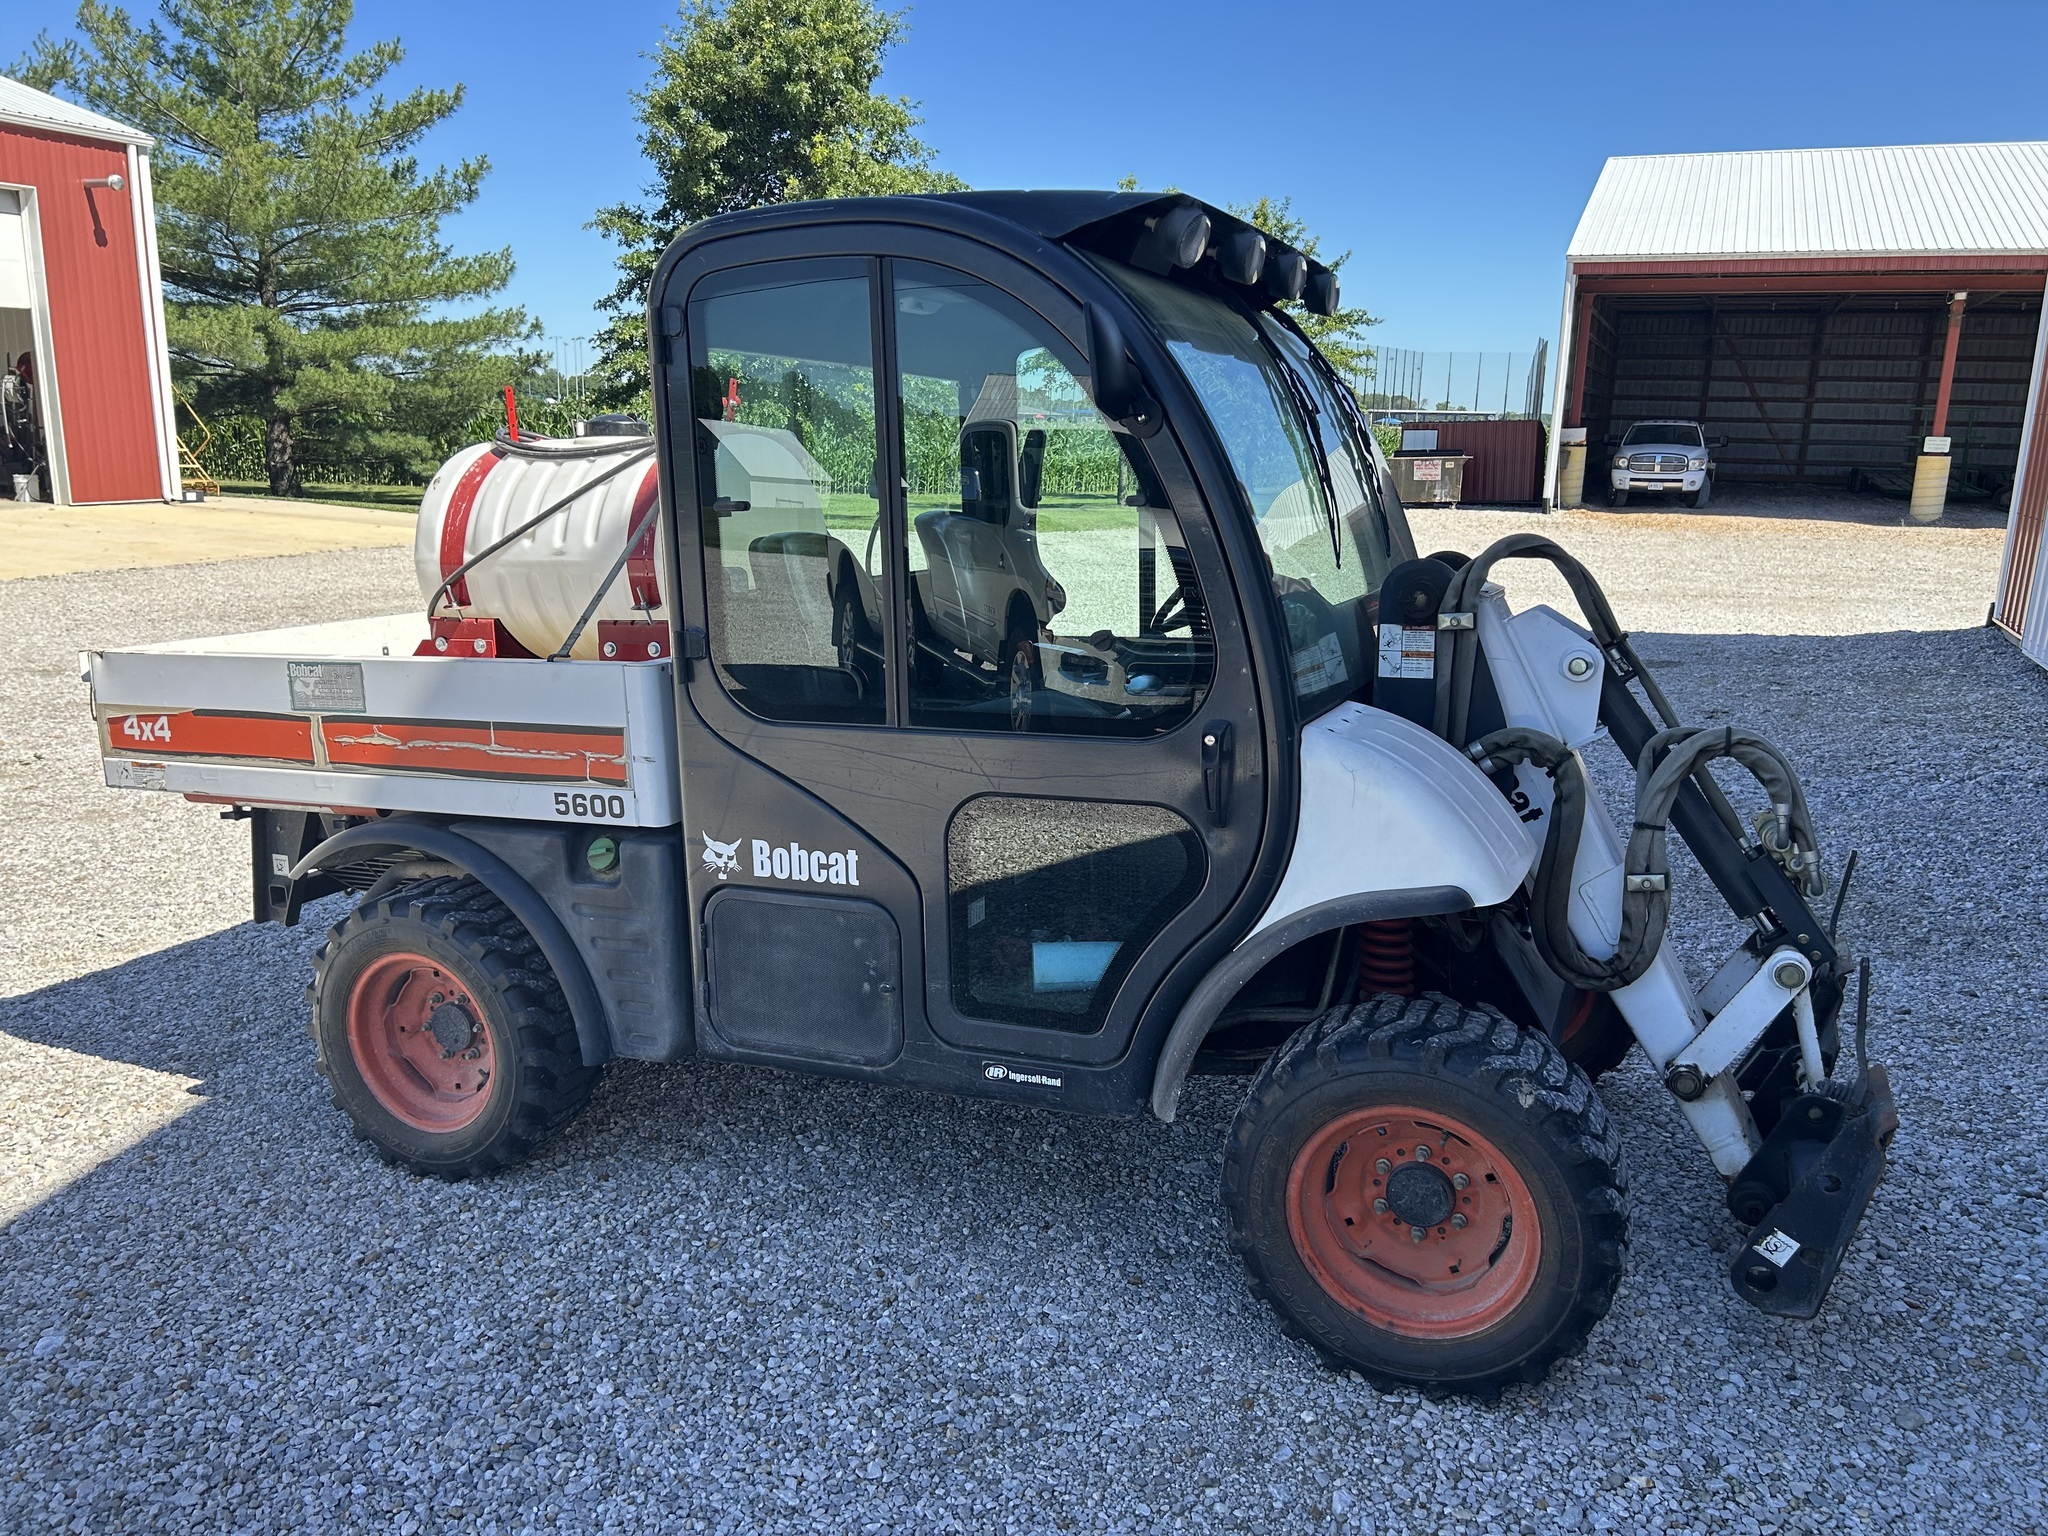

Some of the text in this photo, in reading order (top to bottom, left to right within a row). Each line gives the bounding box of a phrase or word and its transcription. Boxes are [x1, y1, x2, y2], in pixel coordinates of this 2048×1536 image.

[289, 663, 323, 678] Bobcat
[123, 714, 172, 743] 4x4
[553, 792, 626, 819] 5600
[751, 839, 860, 886] Bobcat
[1008, 1070, 1062, 1087] Ingersoll-Rand
